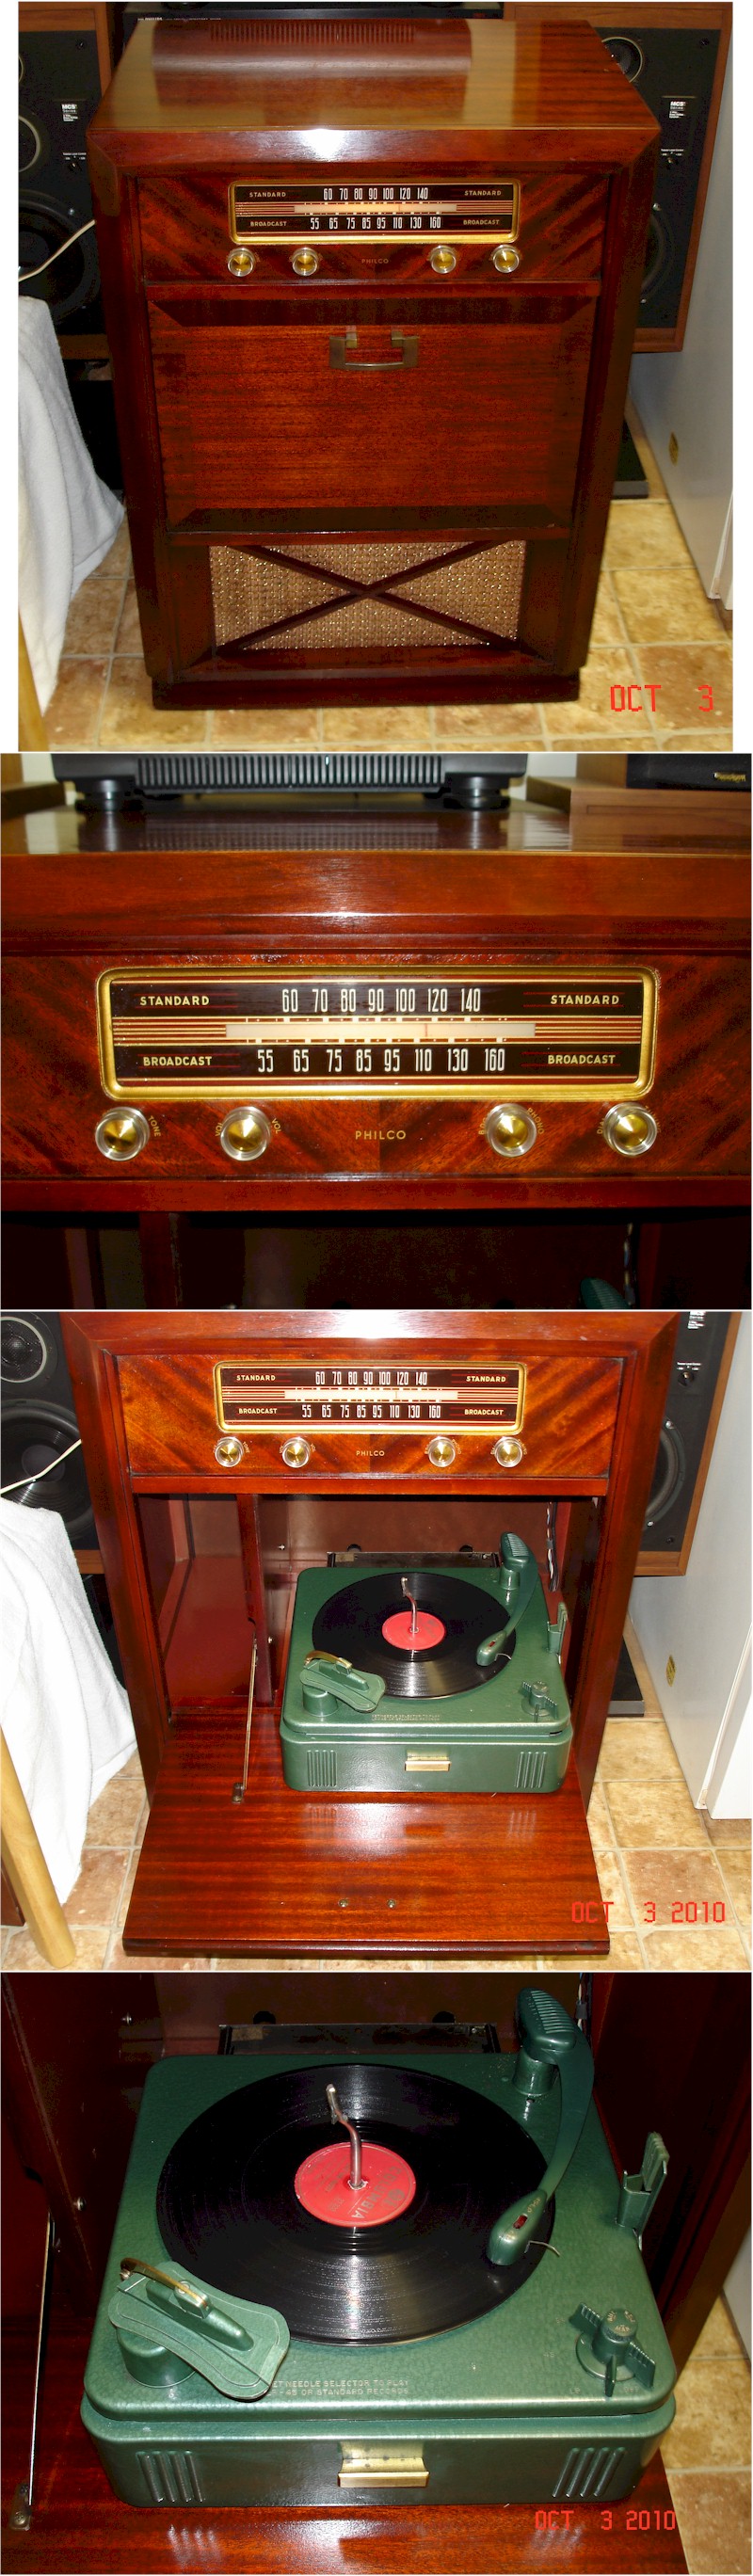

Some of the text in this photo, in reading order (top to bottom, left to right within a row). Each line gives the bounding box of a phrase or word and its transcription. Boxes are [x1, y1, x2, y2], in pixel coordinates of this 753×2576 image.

[324, 187, 428, 200] 60 70 80 90 100 120 140
[311, 216, 441, 230] 55 65 75 85 95 110 130 160
[139, 996, 210, 1006] STANDARD
[282, 987, 481, 1013] 60 70 80 90 100 120 140
[550, 995, 619, 1005] STANDARD
[143, 1056, 213, 1066] BROADCAST
[258, 1048, 505, 1072] 55 65 75 85 95 110 130 160
[548, 1054, 616, 1064] BROADCAST
[148, 1115, 161, 1137] TONE
[271, 1117, 281, 1134] VOL
[527, 1107, 545, 1135] PHONO
[355, 1130, 407, 1140] PHILCO
[315, 1371, 427, 1385] 60 70 80 90 100 120 140
[301, 1405, 441, 1418] 55 65 75 85 95 110 130 160
[351, 2166, 403, 2219] COLUMBIA
[273, 2380, 283, 2389] ET
